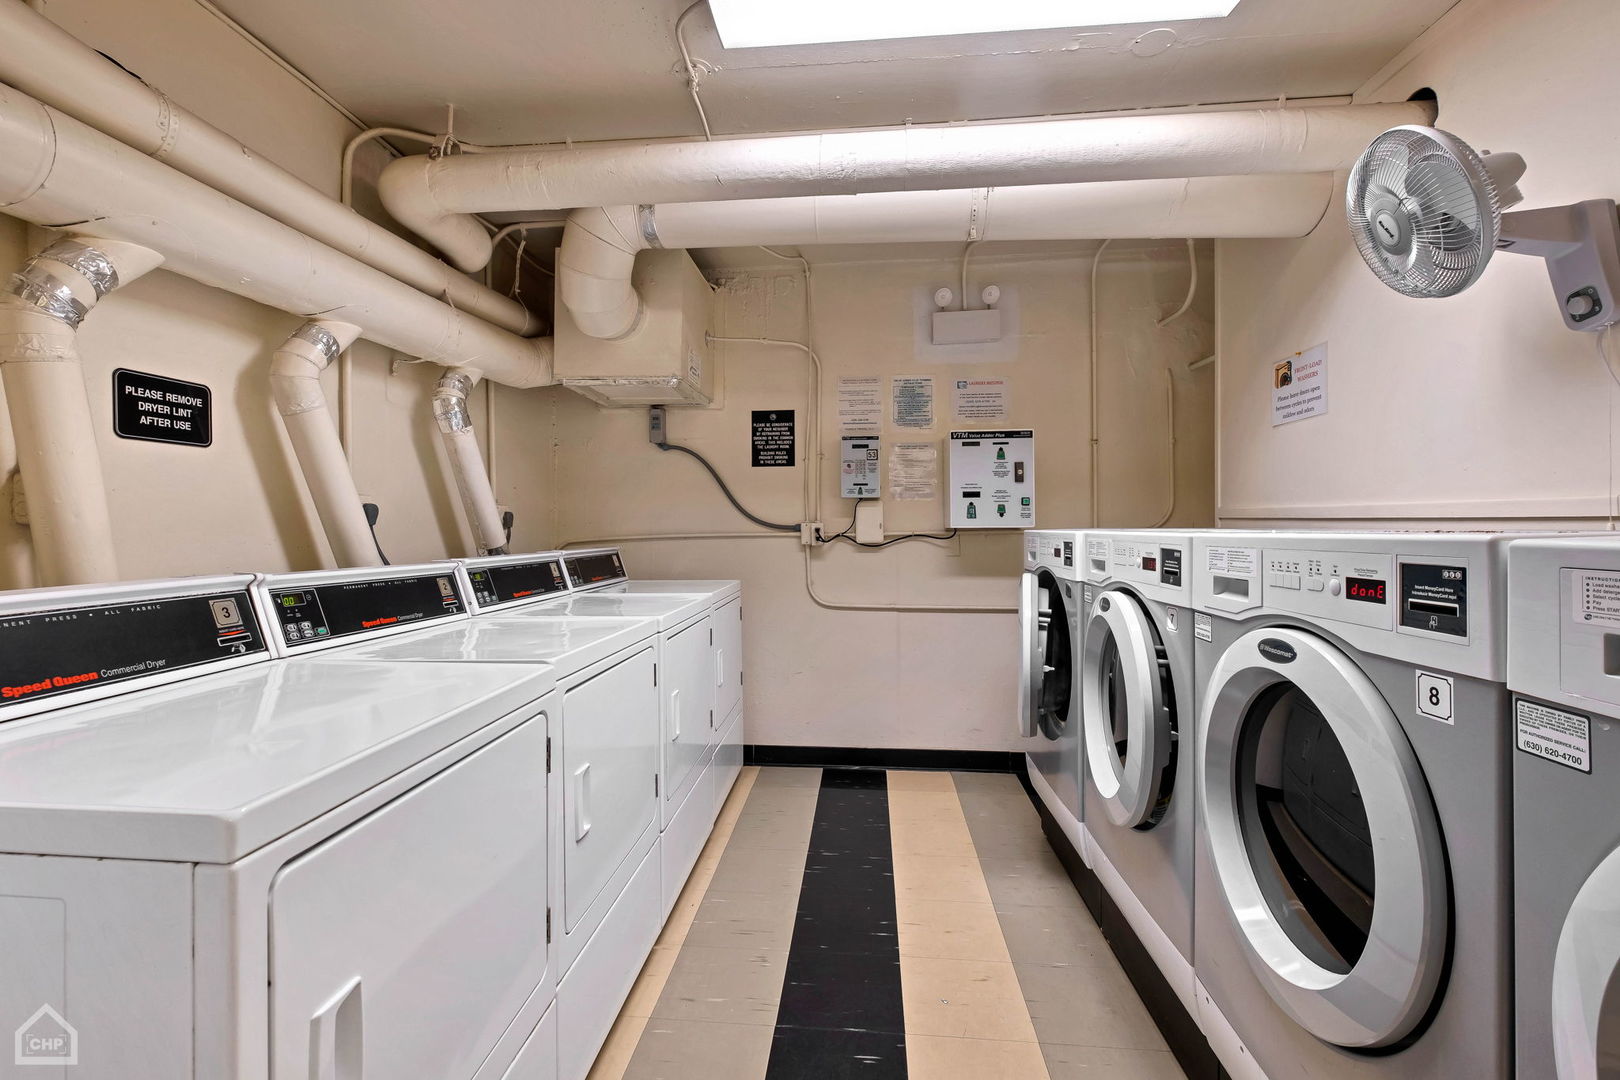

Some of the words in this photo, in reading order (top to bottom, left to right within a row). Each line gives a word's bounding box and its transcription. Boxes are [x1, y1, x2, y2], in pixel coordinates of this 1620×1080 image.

[126, 386, 163, 400] PLEASE
[166, 393, 202, 407] REMOVE
[1310, 385, 1320, 393] open
[138, 402, 170, 414] DRYER
[173, 407, 192, 417] LINT
[140, 416, 170, 427] AFTER
[174, 421, 191, 430] USE
[443, 582, 448, 590] 2
[45, 614, 78, 622] PRESS
[131, 604, 161, 612] FABRIC
[221, 607, 231, 618] 3
[1170, 614, 1174, 624] 7
[362, 619, 380, 628] Speed
[101, 662, 146, 678] Commercial
[146, 658, 166, 669] Dryer
[1, 680, 52, 698] Speed
[52, 672, 98, 688] Queen
[1429, 687, 1440, 706] 8
[1528, 731, 1553, 742] AUTHORIZED
[1554, 740, 1572, 748] SERVICE
[1524, 740, 1542, 753] (630)
[1544, 747, 1582, 765] 620-4700
